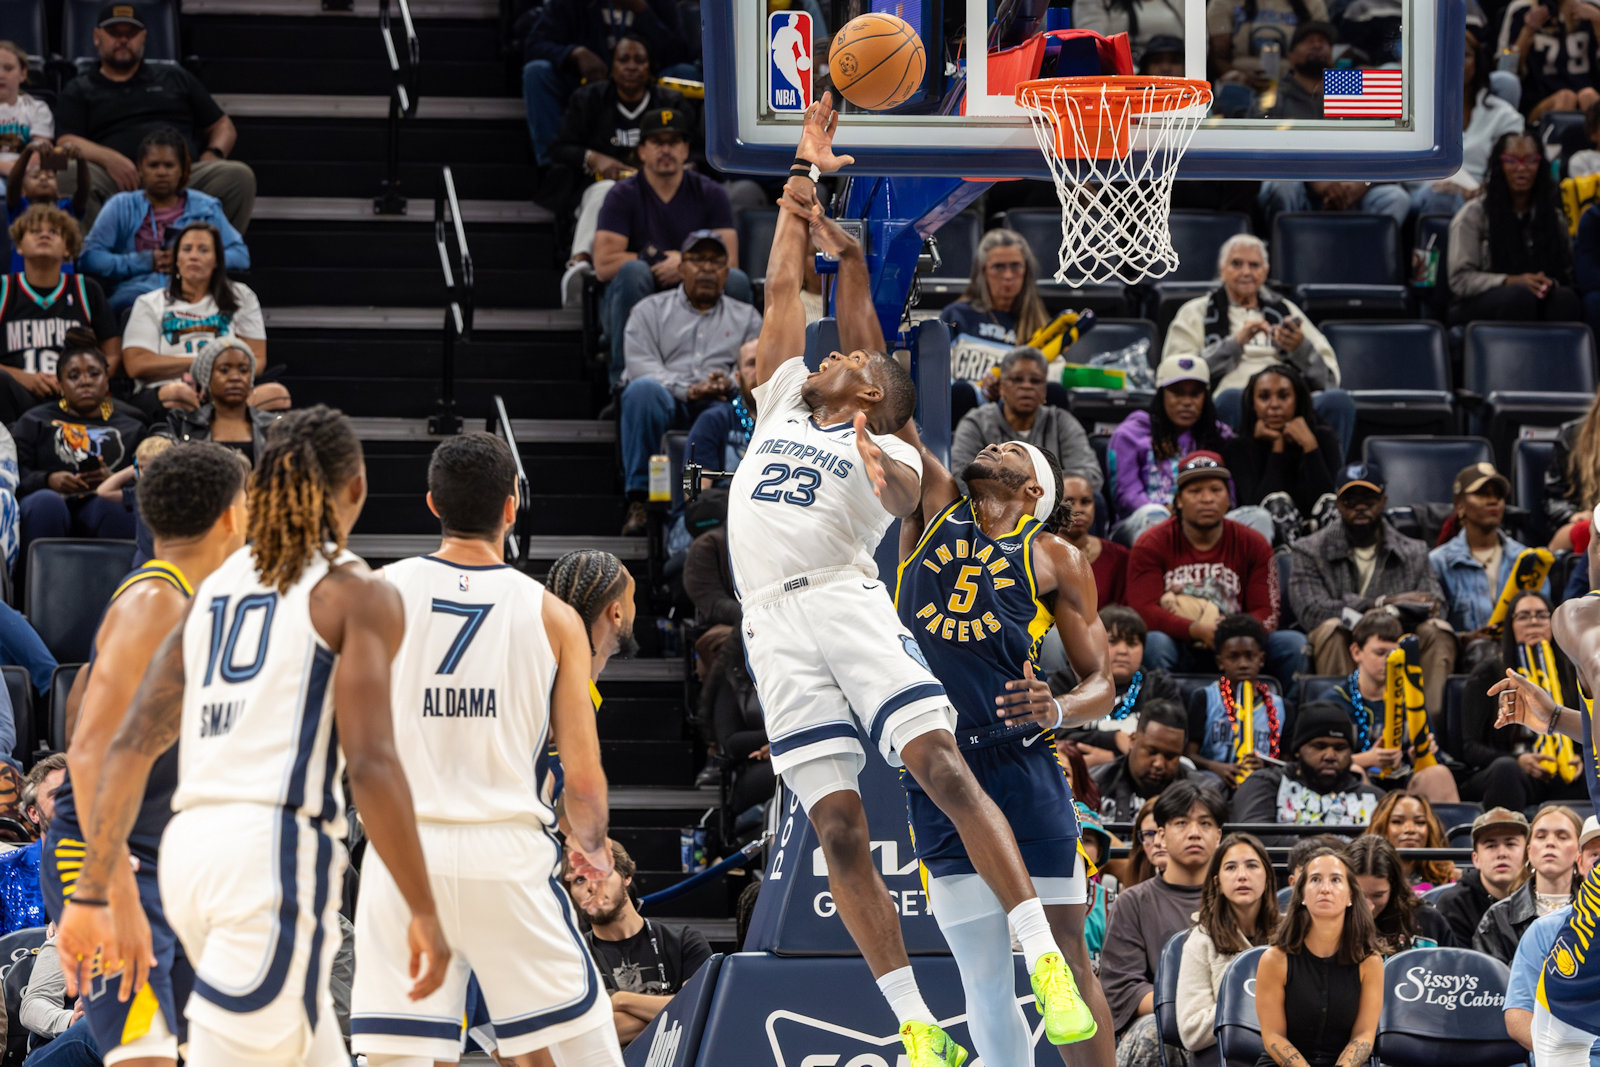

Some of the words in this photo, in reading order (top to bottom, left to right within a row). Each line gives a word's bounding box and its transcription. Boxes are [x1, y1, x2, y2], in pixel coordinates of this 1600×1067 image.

[775, 89, 797, 106] NBA
[661, 109, 674, 125] P
[6, 317, 81, 353] MEMPH
[23, 349, 60, 375] 16
[755, 438, 854, 479] MEMPHIS
[750, 462, 822, 507] 23
[947, 564, 983, 614] 5
[202, 592, 279, 687] 10
[431, 597, 496, 675] 7
[915, 601, 1002, 642] PACERS
[422, 687, 498, 718] ALDAMA
[1394, 966, 1479, 1001] Sissy's
[1425, 988, 1457, 1010] Log
